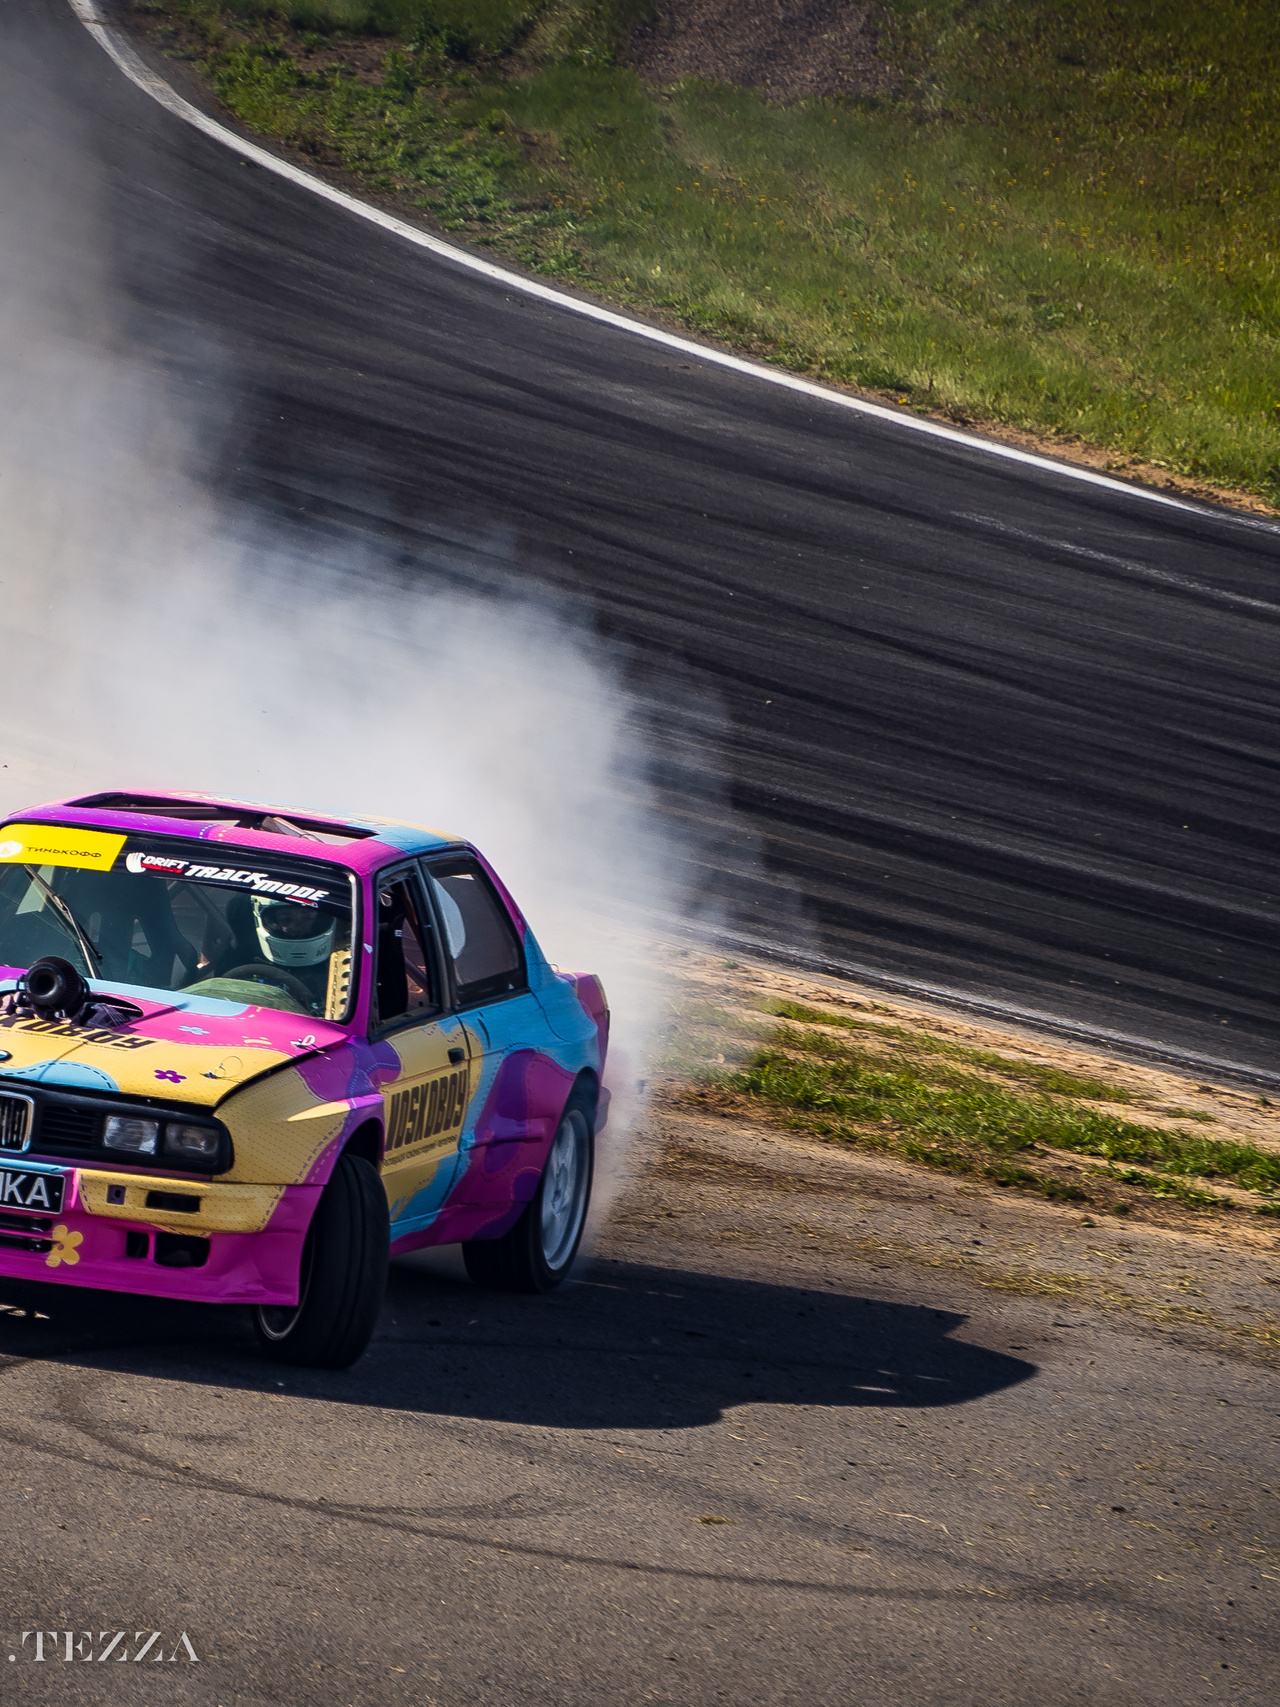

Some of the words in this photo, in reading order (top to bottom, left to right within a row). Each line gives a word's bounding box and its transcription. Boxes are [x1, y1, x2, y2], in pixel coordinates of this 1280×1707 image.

[26, 846, 102, 858] ТИНЬКОФФ
[142, 854, 190, 870] DRIFT
[384, 1069, 467, 1152] VOSKOBOY
